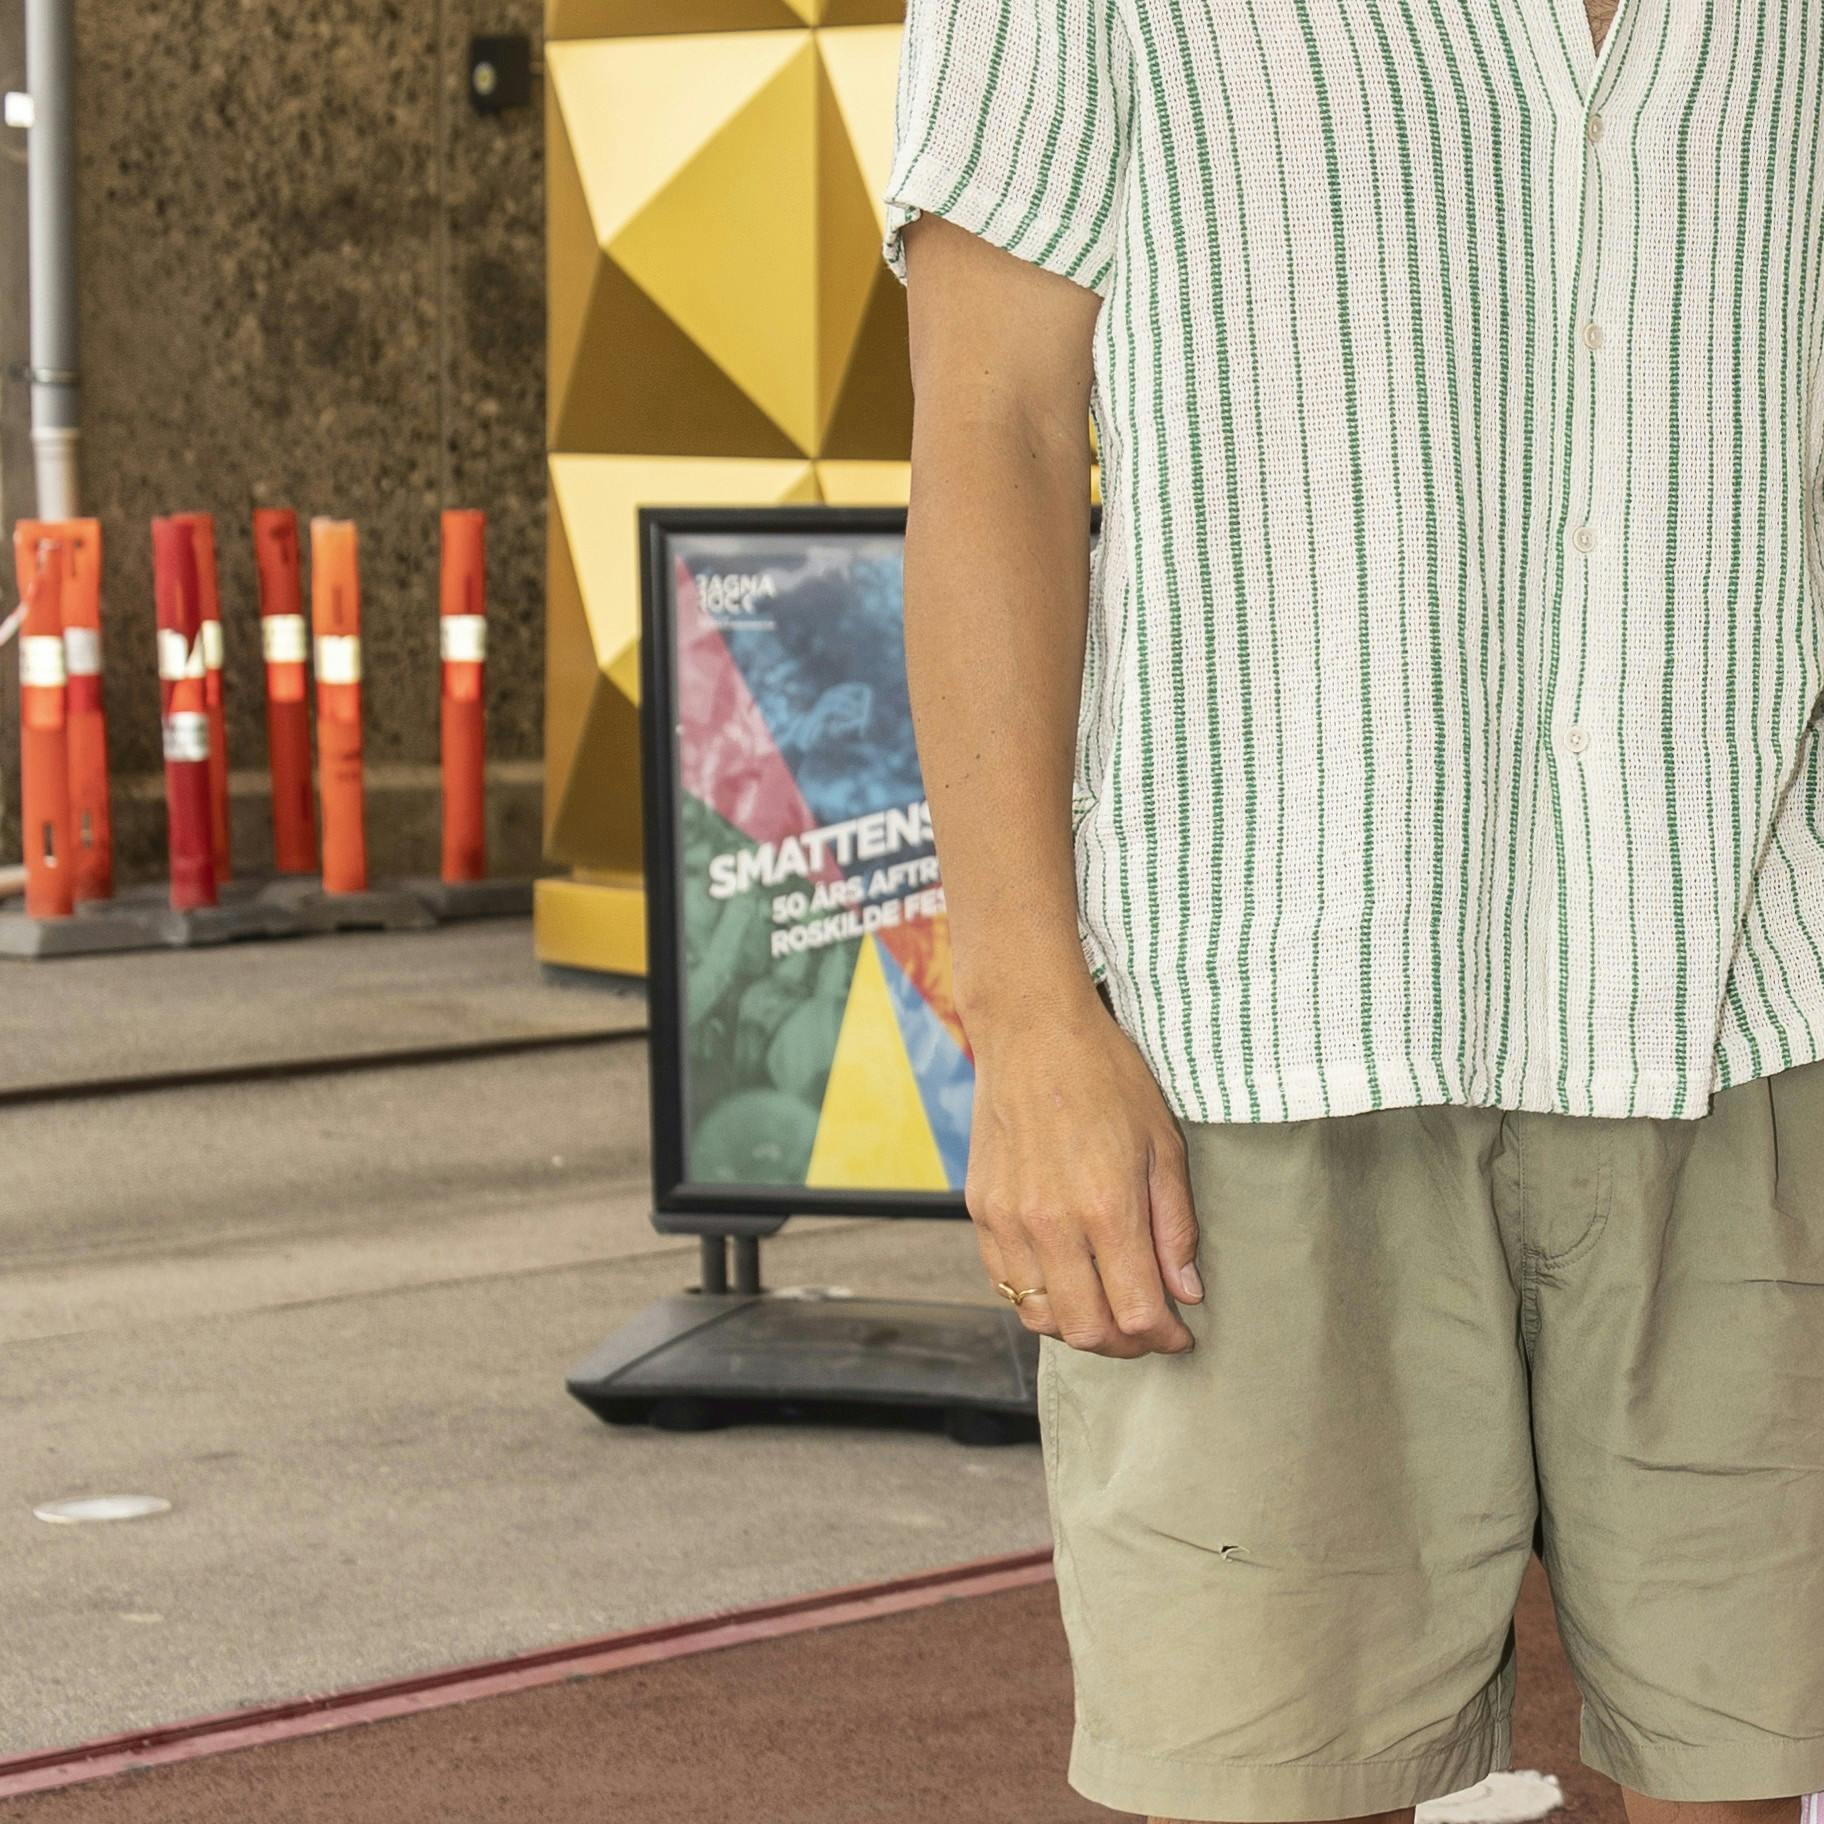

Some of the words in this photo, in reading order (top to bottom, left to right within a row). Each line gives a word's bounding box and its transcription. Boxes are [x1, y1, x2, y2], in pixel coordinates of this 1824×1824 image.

[771, 891, 808, 924] 50
[810, 874, 866, 913] ÅRS
[771, 898, 901, 959] ROSKILDE
